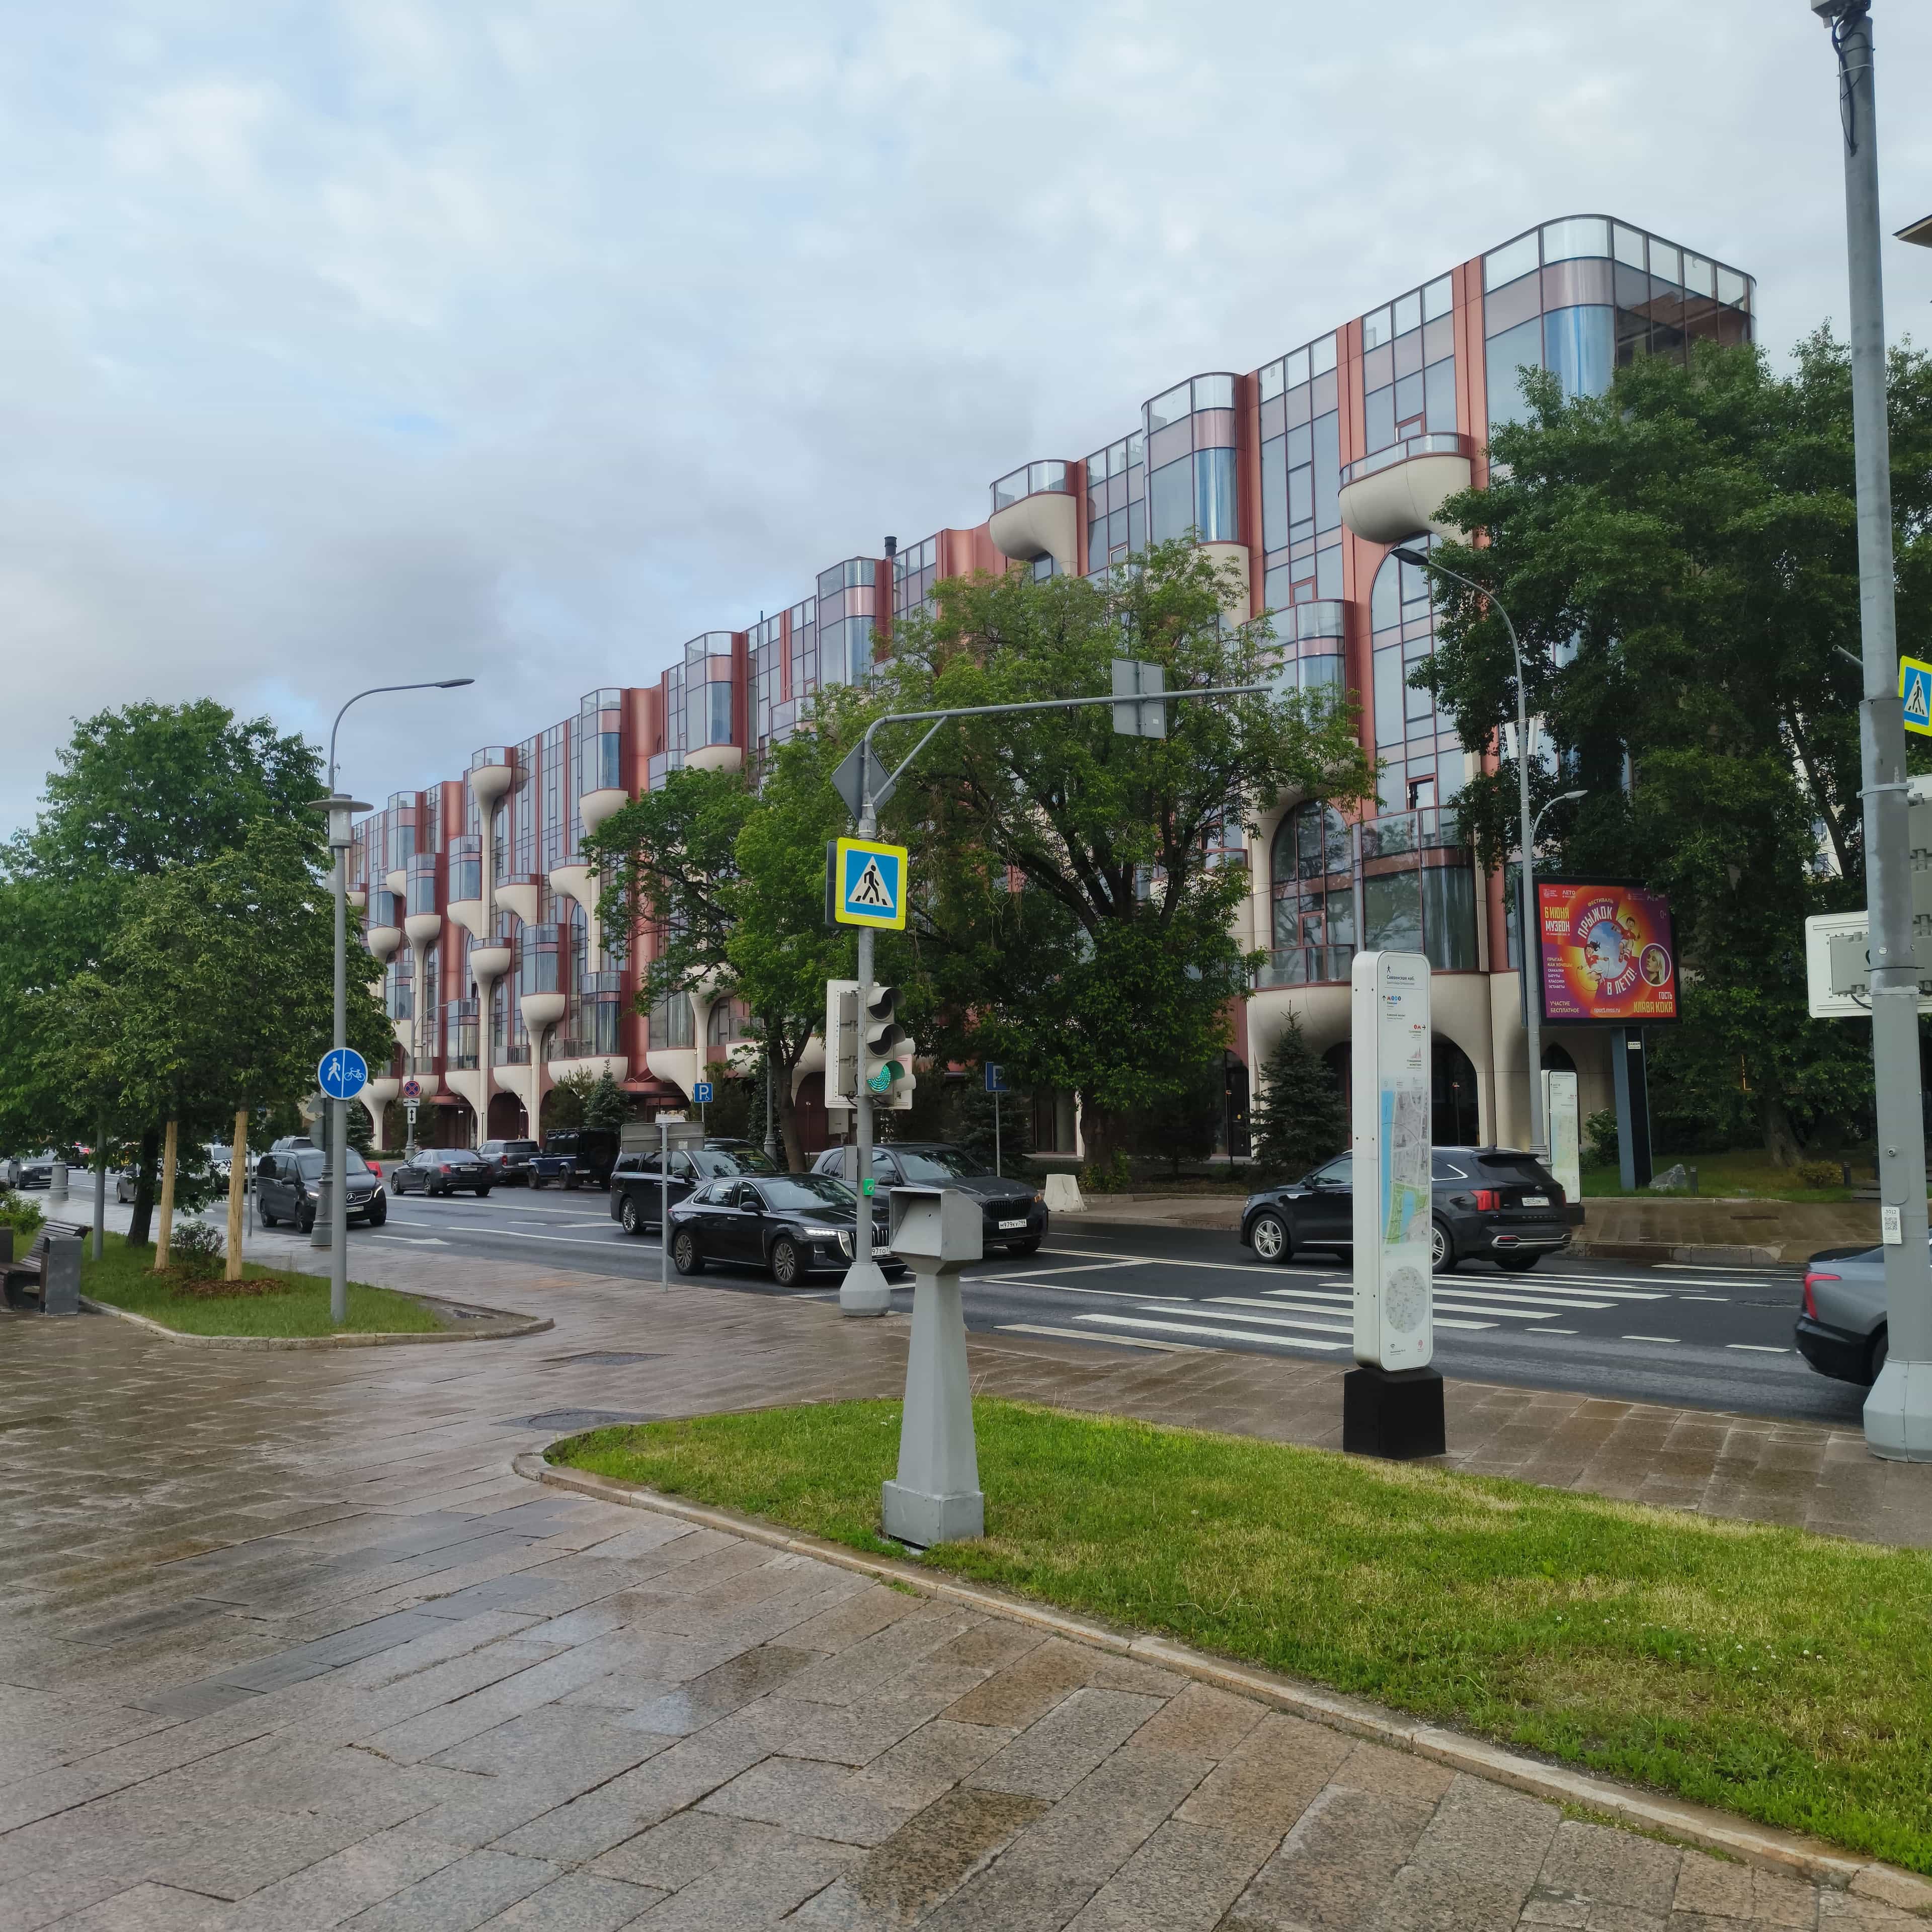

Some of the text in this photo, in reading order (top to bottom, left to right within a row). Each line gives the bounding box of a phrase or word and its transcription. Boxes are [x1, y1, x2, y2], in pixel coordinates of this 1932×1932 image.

[1545, 907, 1570, 919] 6 ИЮНЯ
[1545, 921, 1570, 932] МУЗЕОН
[1578, 906, 1613, 939] ПРЫЖОК
[1607, 967, 1637, 995] В ЛЕТО!
[1659, 992, 1673, 1000] ГОСТЬ
[1634, 1001, 1673, 1013] КЛАВА КОКА
[699, 1085, 709, 1100] P
